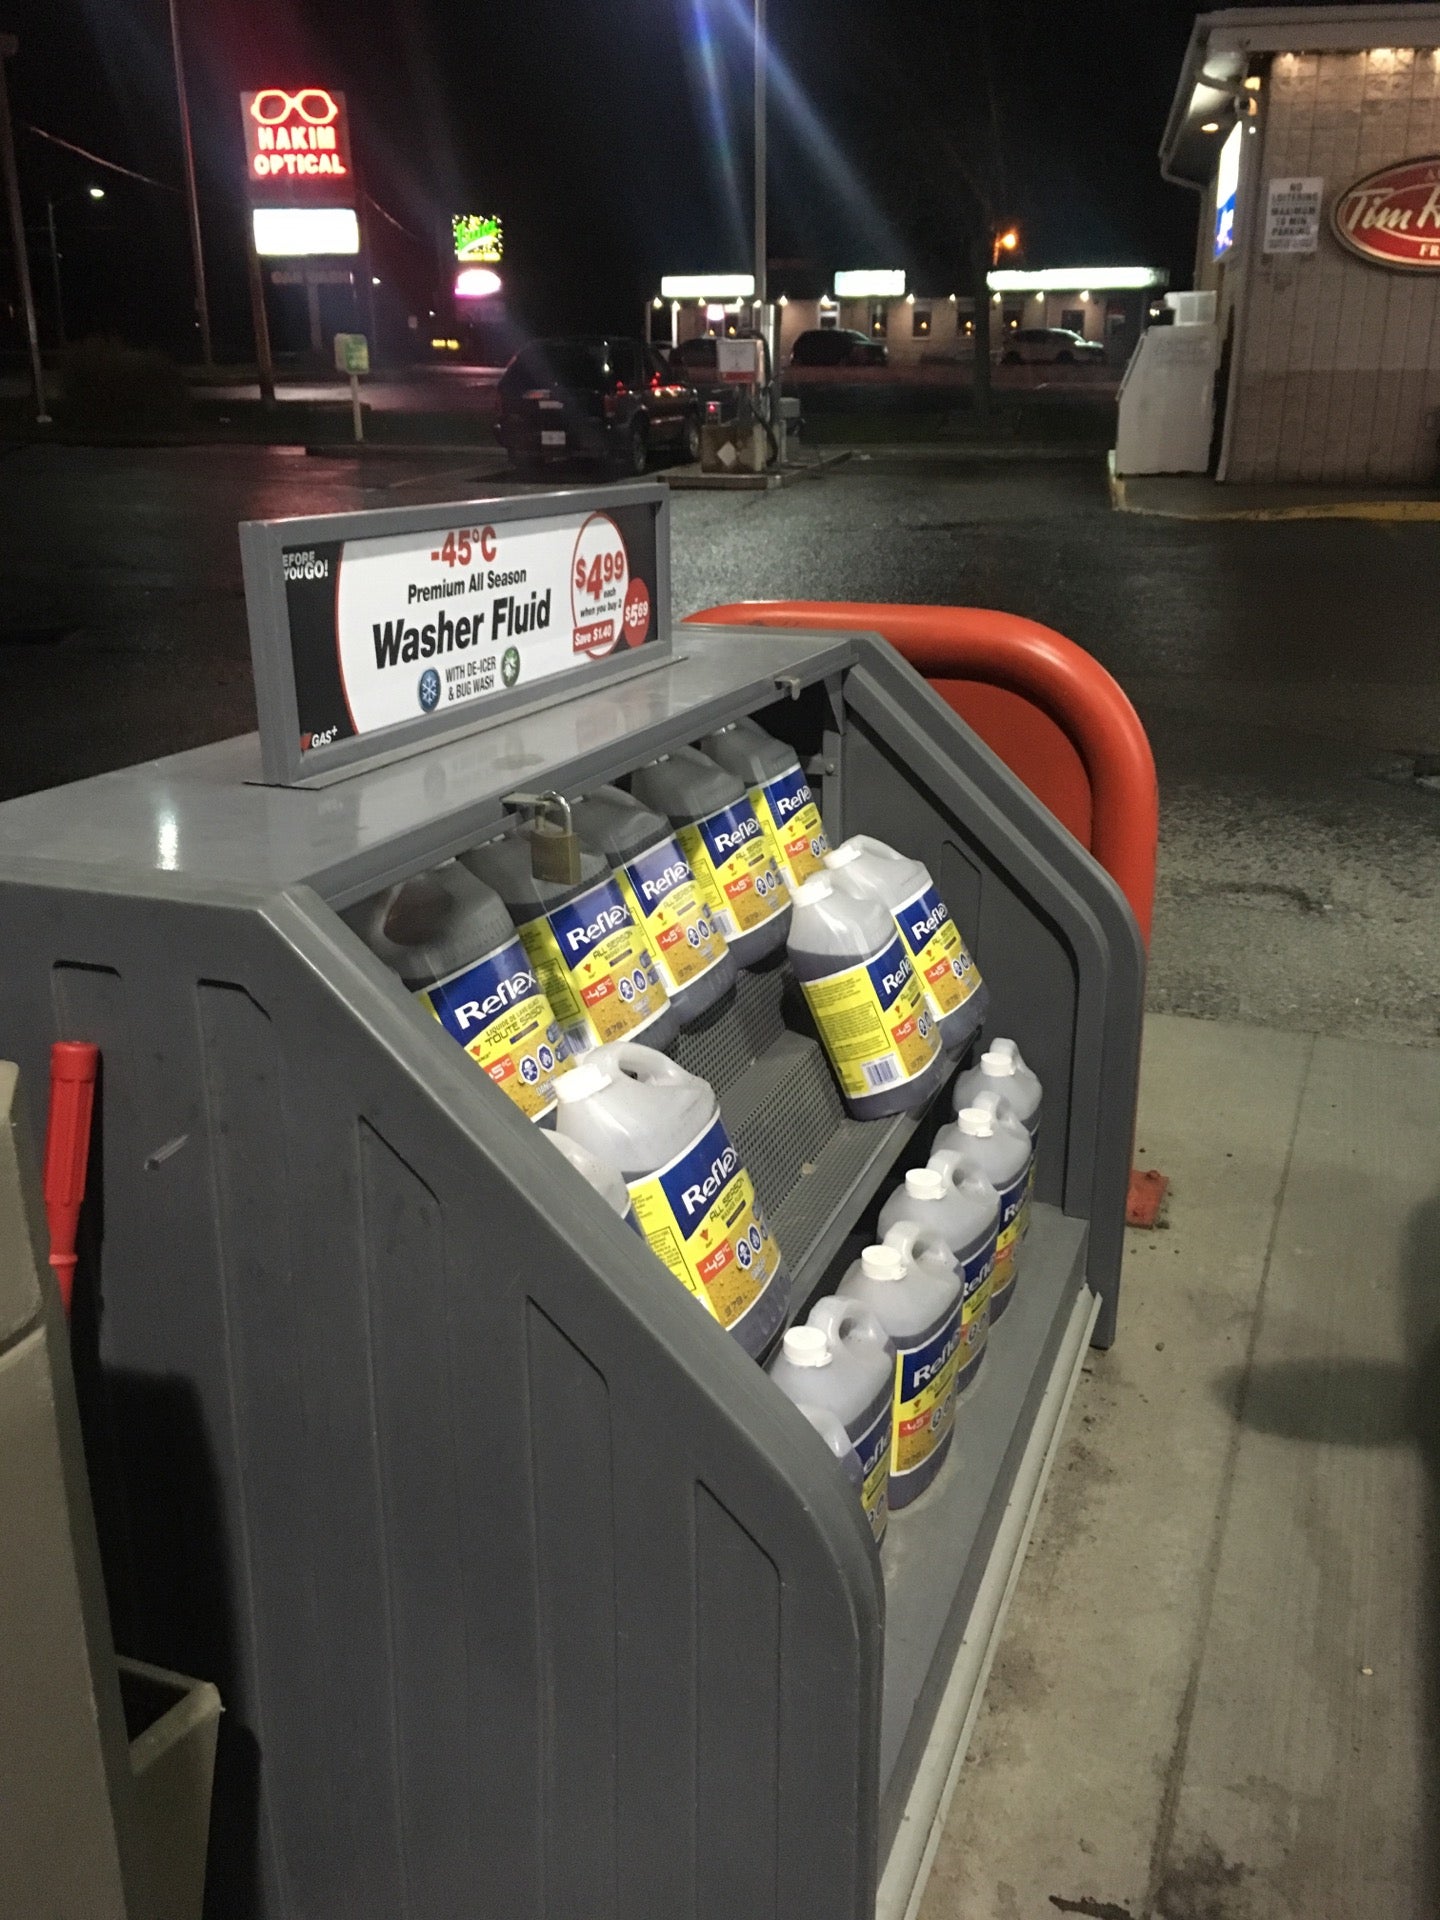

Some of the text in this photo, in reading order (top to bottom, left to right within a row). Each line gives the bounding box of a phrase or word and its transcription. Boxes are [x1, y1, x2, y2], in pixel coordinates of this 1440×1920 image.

[253, 153, 346, 175] OPTICAL
[1347, 187, 1413, 231] Tim
[283, 551, 315, 567] EFORE
[432, 525, 497, 568] -45°C
[284, 560, 329, 580] YOU GO!
[409, 570, 527, 604] Premium All Season
[604, 588, 616, 599] each
[581, 607, 595, 618] when
[597, 606, 606, 616] you
[608, 602, 617, 612] buy
[373, 589, 551, 670] Washer Fluid
[575, 634, 591, 646] Save
[446, 657, 496, 684] WITH DE-ICER
[449, 677, 495, 701] & BUG WASH
[642, 862, 691, 900] Reflex
[567, 905, 631, 951] Reflex
[594, 949, 607, 960] ALL
[883, 956, 912, 995] Refle
[455, 970, 538, 1030] Reflex
[486, 1022, 520, 1046] TOUTE
[682, 1147, 738, 1215] Reflex
[711, 1206, 724, 1222] ALL
